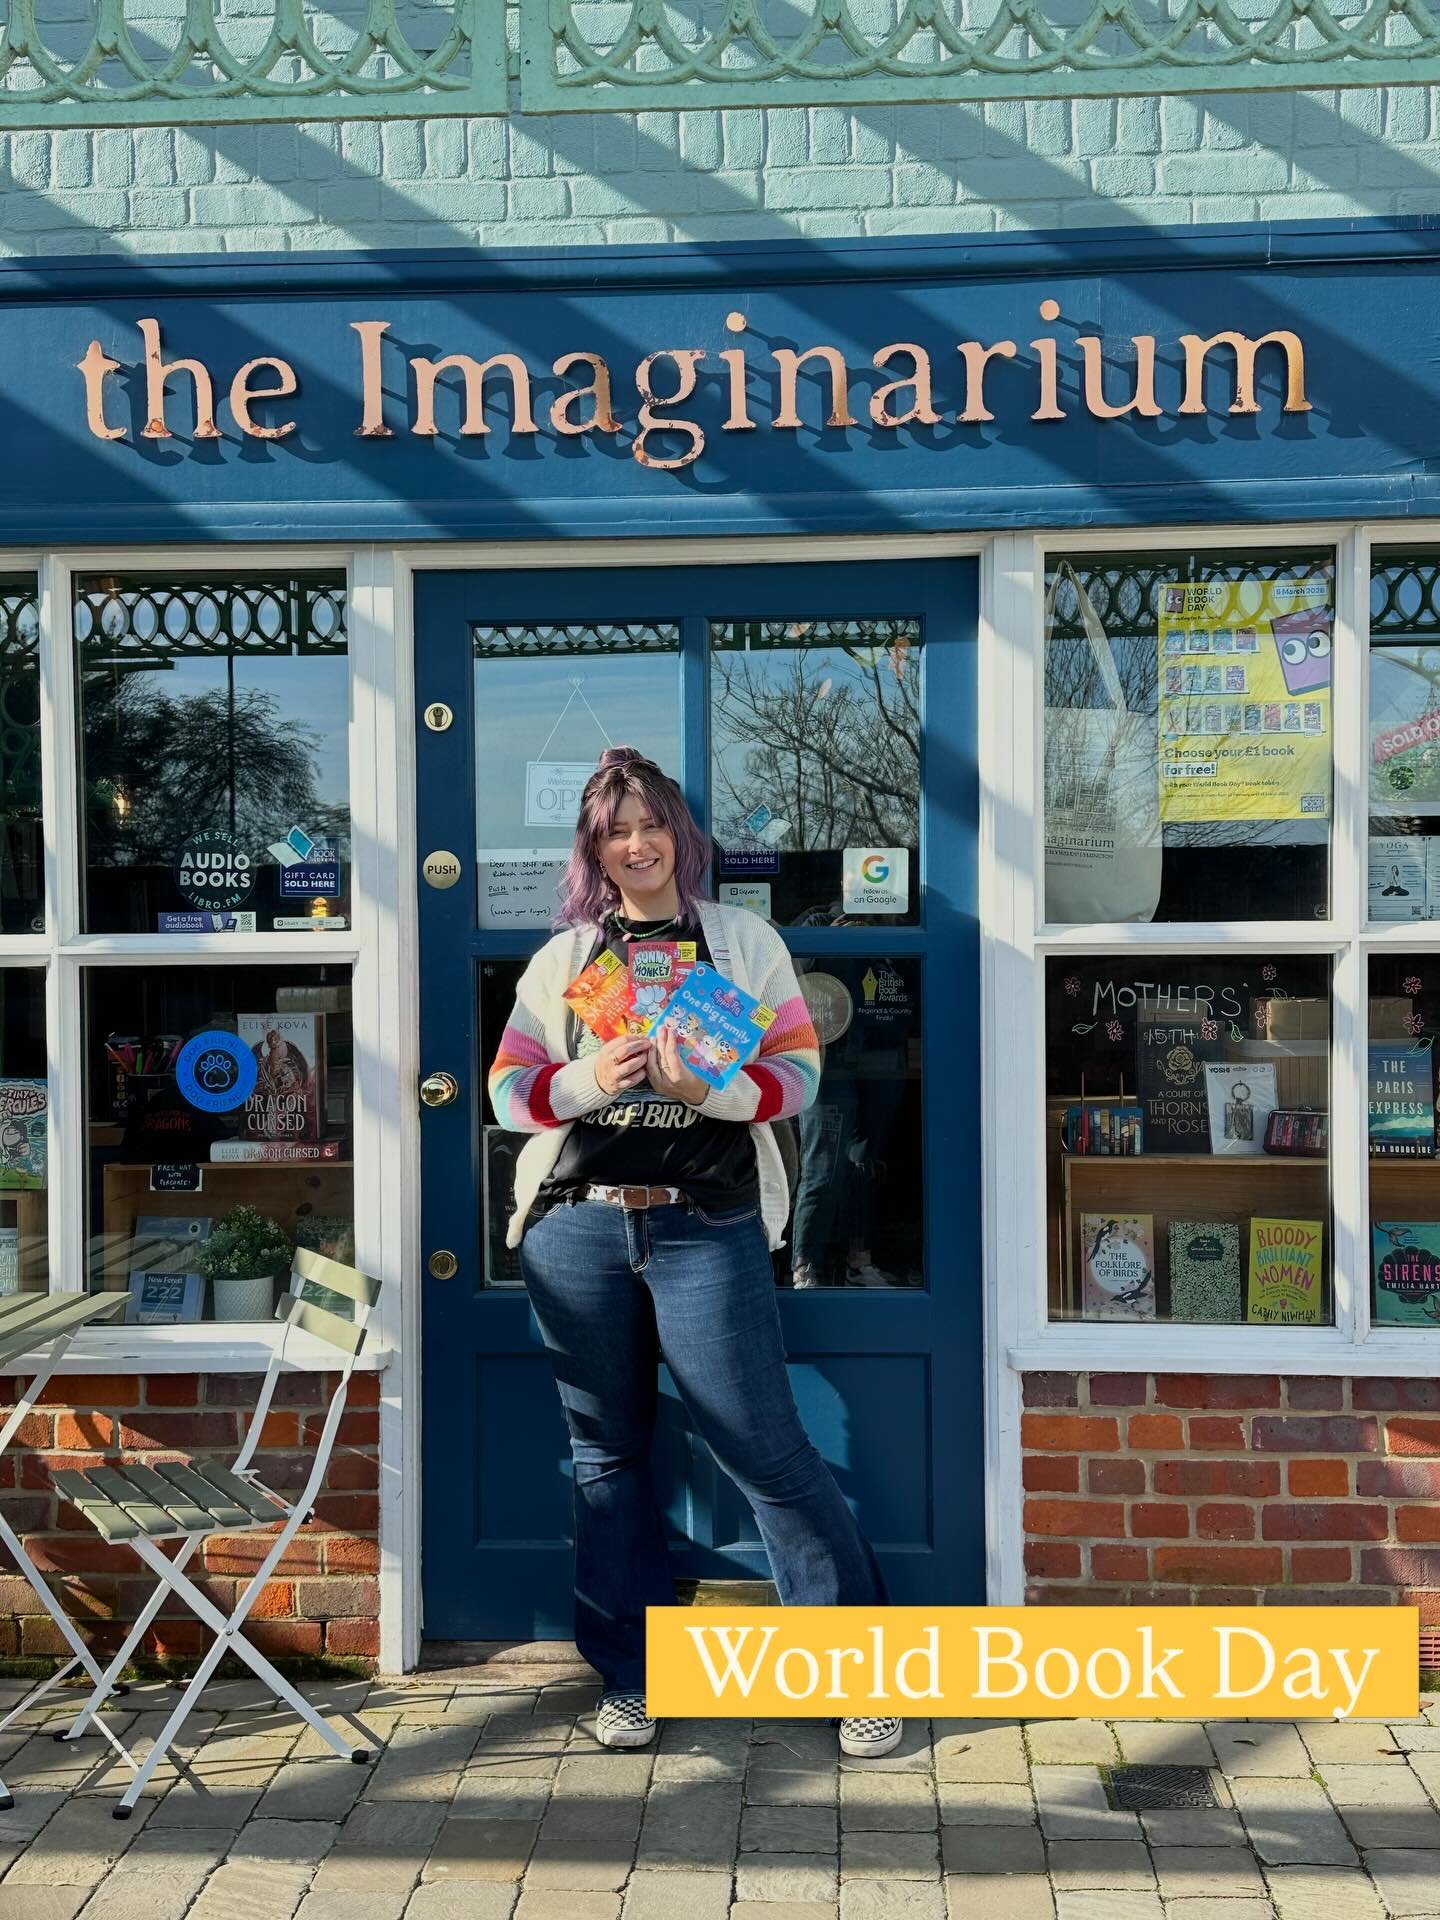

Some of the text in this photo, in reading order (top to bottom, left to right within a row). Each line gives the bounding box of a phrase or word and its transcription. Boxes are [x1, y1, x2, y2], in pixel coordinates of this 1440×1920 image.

[76, 299, 1314, 470] the Imaginarium
[1187, 587, 1222, 596] WORLD
[1282, 587, 1305, 595] March
[1187, 596, 1214, 604] BOOK
[1187, 604, 1206, 612] DAY
[1382, 726, 1424, 752] SOLD
[1164, 747, 1212, 758] Choose
[1215, 748, 1242, 760] your
[1262, 745, 1295, 756] book
[1165, 763, 1215, 775] for free!
[536, 788, 583, 810] OP
[192, 831, 241, 847] WE SELL
[1046, 834, 1114, 849] aginarium
[180, 852, 250, 870] AUDIO
[724, 857, 775, 865] SOLD HERE
[427, 865, 457, 874] PUSH
[180, 870, 251, 888] BOOKS
[284, 880, 335, 888] SOLD HERE
[867, 895, 897, 905] Google
[634, 950, 672, 965] BUNNY
[634, 965, 671, 977] MONKEY
[879, 970, 894, 979] The
[879, 986, 898, 994] Book
[878, 993, 908, 1002] Awards
[682, 990, 700, 1007] One
[701, 1002, 720, 1022] Big
[718, 1015, 751, 1044] Family
[242, 1021, 308, 1030] ELISE KOVA
[1148, 1029, 1194, 1045] 15TH
[1381, 1060, 1406, 1073] THE
[8, 1089, 30, 1099] TINY
[1376, 1081, 1414, 1094] PARIS
[0, 1094, 47, 1115] ERCULES
[245, 1094, 308, 1112] DRAGON
[1368, 1101, 1424, 1114] EXPRESS
[247, 1113, 305, 1131] CURSED
[1168, 1119, 1208, 1135] ROSE
[244, 1147, 320, 1159] DRAGON CURSED
[1256, 1227, 1317, 1249] BLOODY
[1256, 1246, 1315, 1268] BRILLIANT
[1095, 1261, 1142, 1269] FOLKLORE
[148, 1275, 163, 1283] New
[1099, 1269, 1139, 1277] OF BIRDS
[1255, 1264, 1316, 1291] WOMEN
[1383, 1264, 1440, 1281] SIRENS
[146, 1286, 182, 1299] 222
